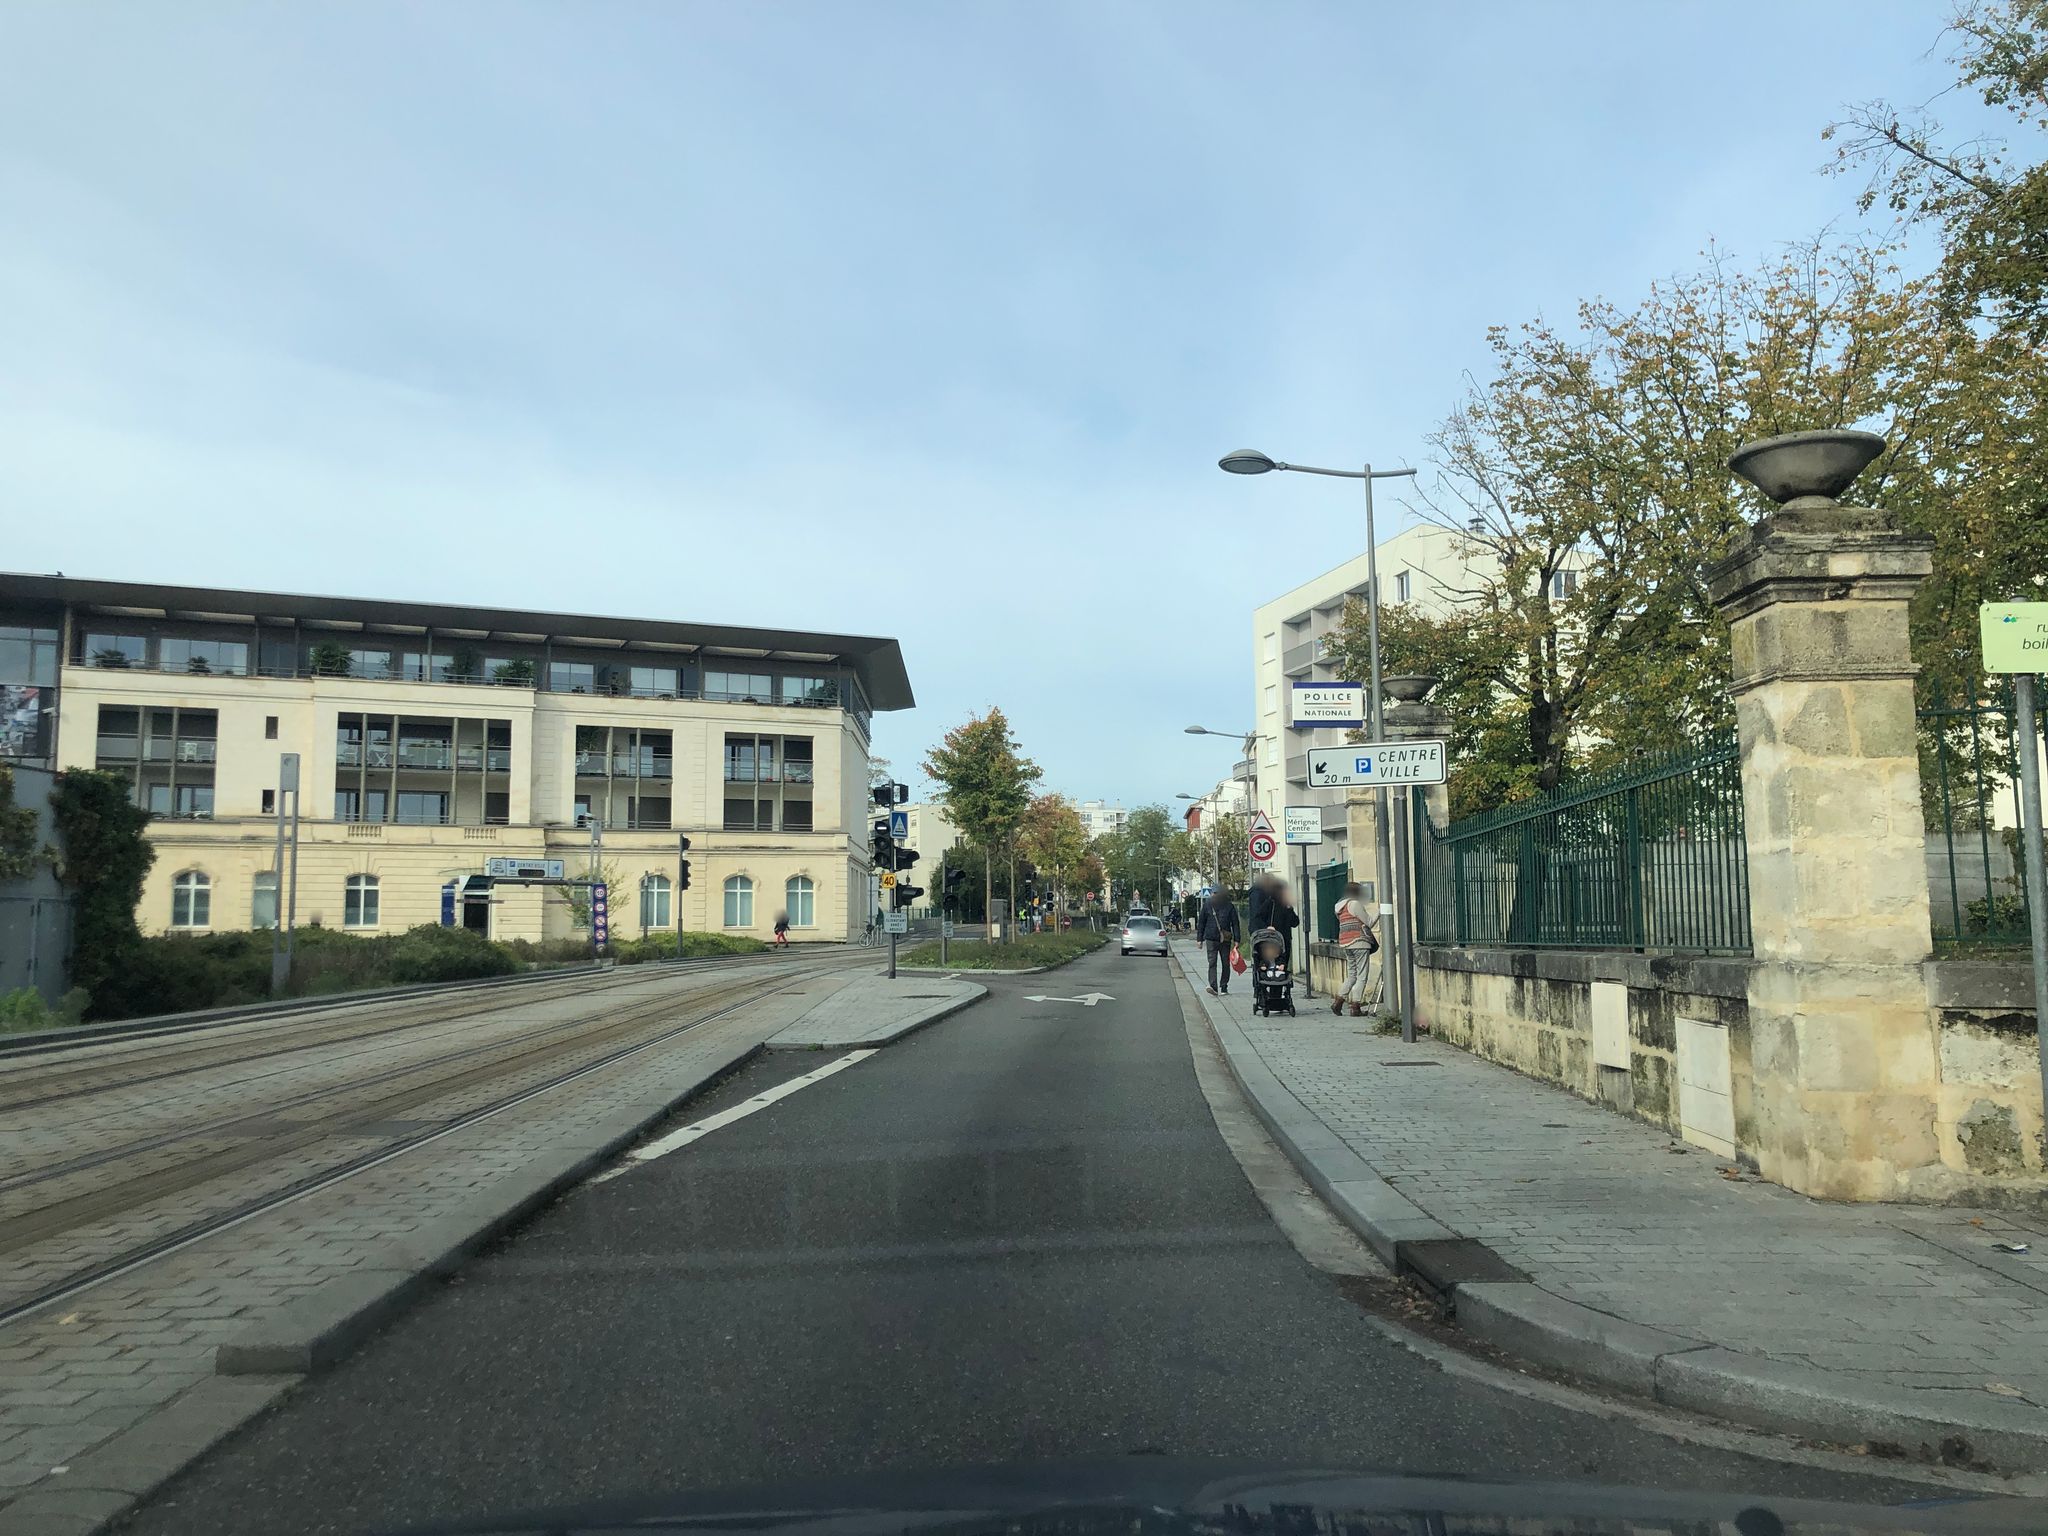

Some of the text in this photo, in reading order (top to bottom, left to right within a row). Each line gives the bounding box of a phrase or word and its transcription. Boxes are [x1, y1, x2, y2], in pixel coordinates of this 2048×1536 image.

[1304, 693, 1352, 701] POLICE
[1304, 709, 1352, 717] NATIONALE
[1378, 748, 1438, 763] CENTRE
[1379, 765, 1420, 778] VILLE
[1324, 774, 1351, 784] 20 m
[1254, 841, 1271, 854] 30
[884, 875, 895, 886] 40
